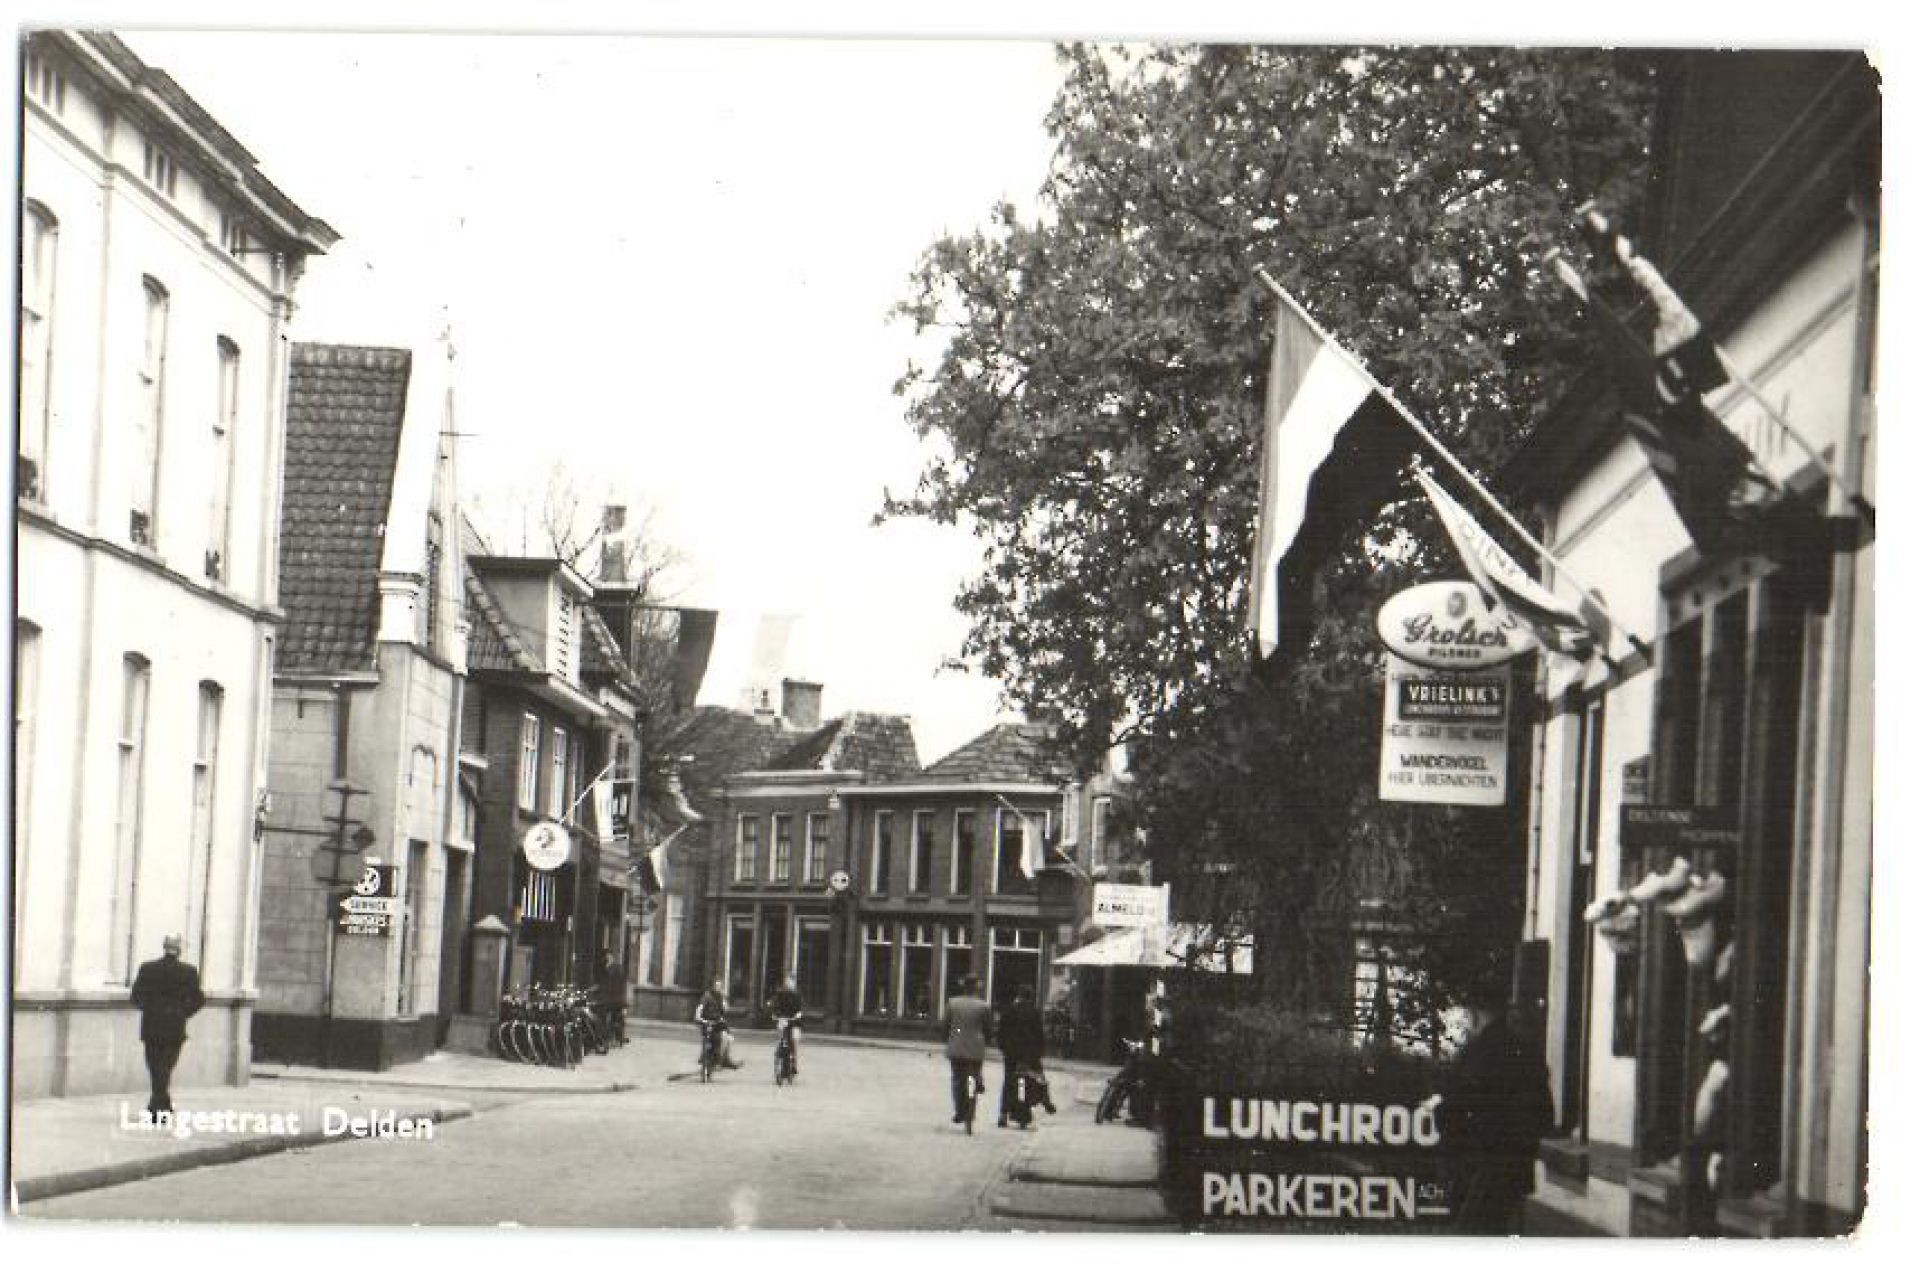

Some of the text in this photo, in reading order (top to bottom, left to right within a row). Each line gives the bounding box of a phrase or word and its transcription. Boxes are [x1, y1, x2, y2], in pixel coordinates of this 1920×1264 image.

[1403, 614, 1507, 646] Grolsch
[1400, 753, 1488, 770] WANDERVOGEL
[1203, 1096, 1441, 1147] LUNCHROO
[1203, 1172, 1415, 1219] PARKEREN
